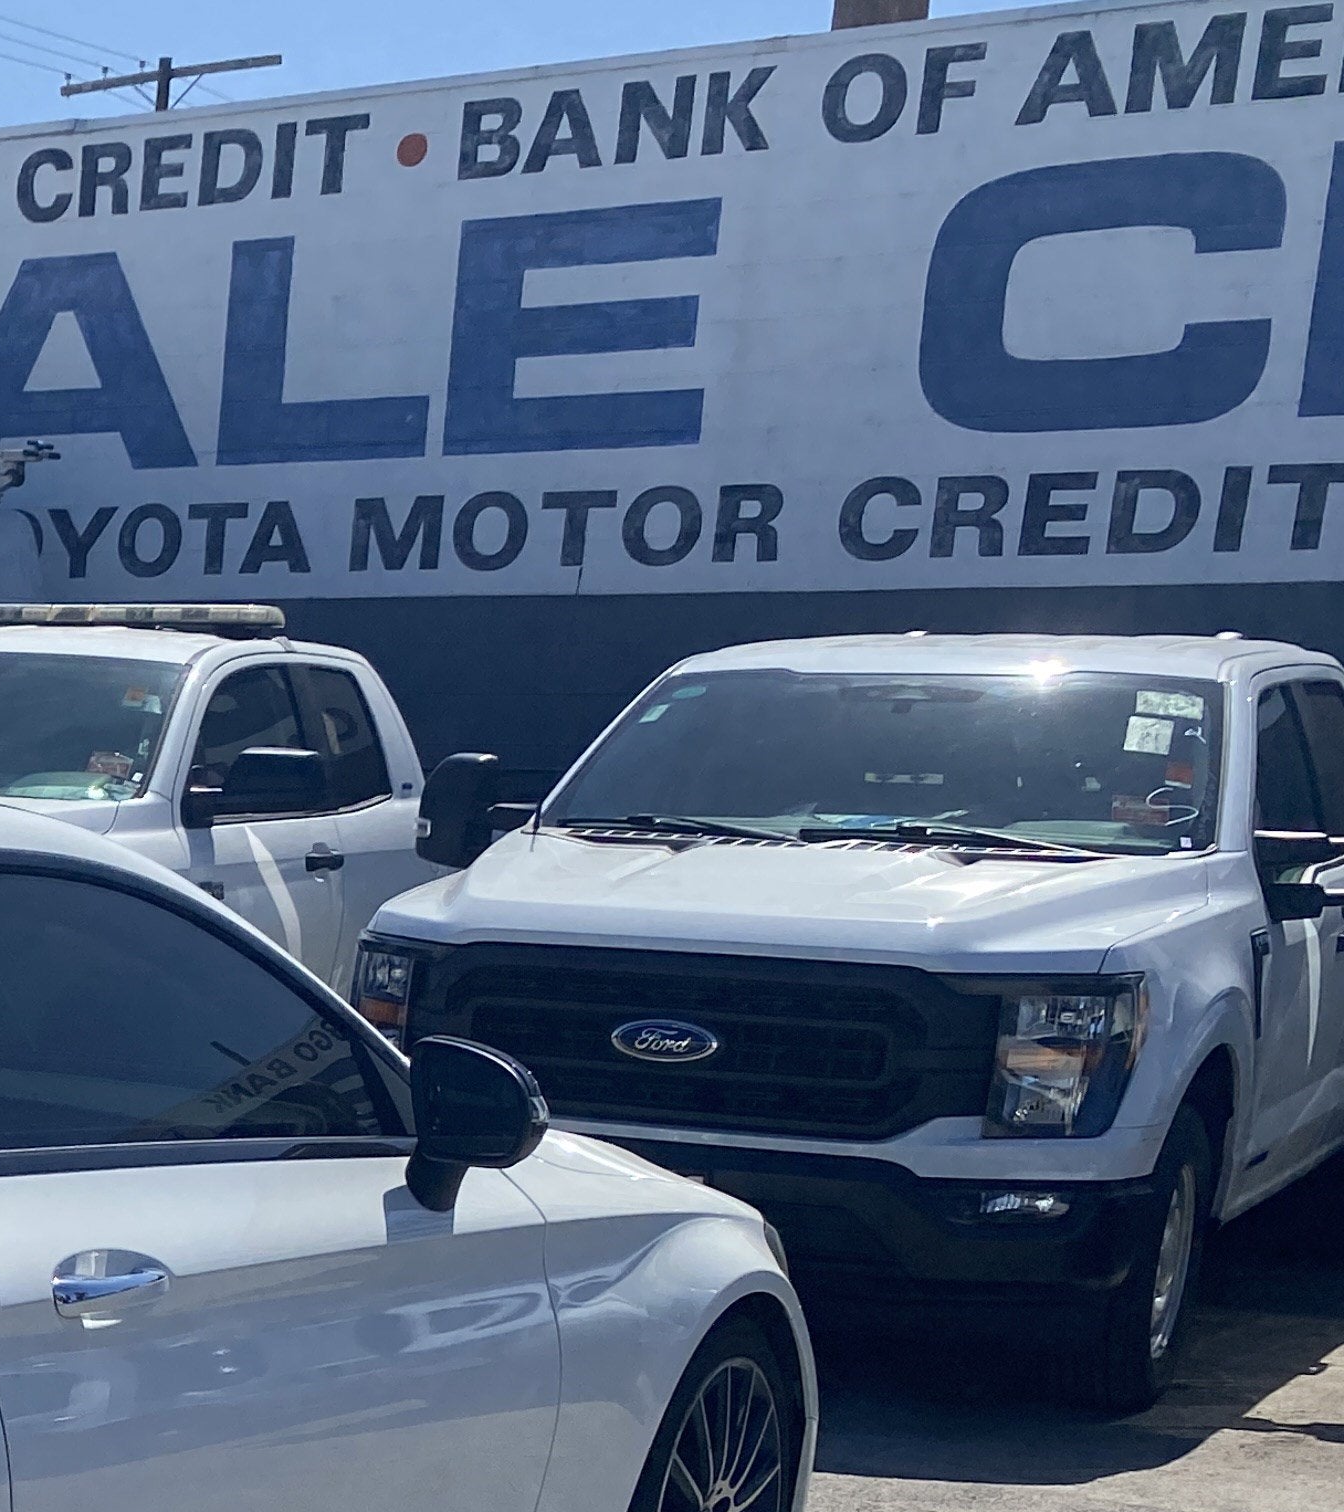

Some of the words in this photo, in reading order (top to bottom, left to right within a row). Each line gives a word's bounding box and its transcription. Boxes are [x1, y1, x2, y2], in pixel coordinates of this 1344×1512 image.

[16, 113, 370, 224] CREDIT
[457, 65, 778, 181] BANK
[820, 42, 988, 143] OF
[918, 140, 1344, 434] C
[348, 484, 785, 573] MOTOR
[837, 463, 1344, 562] CREDIT
[634, 1027, 692, 1053] Ford
